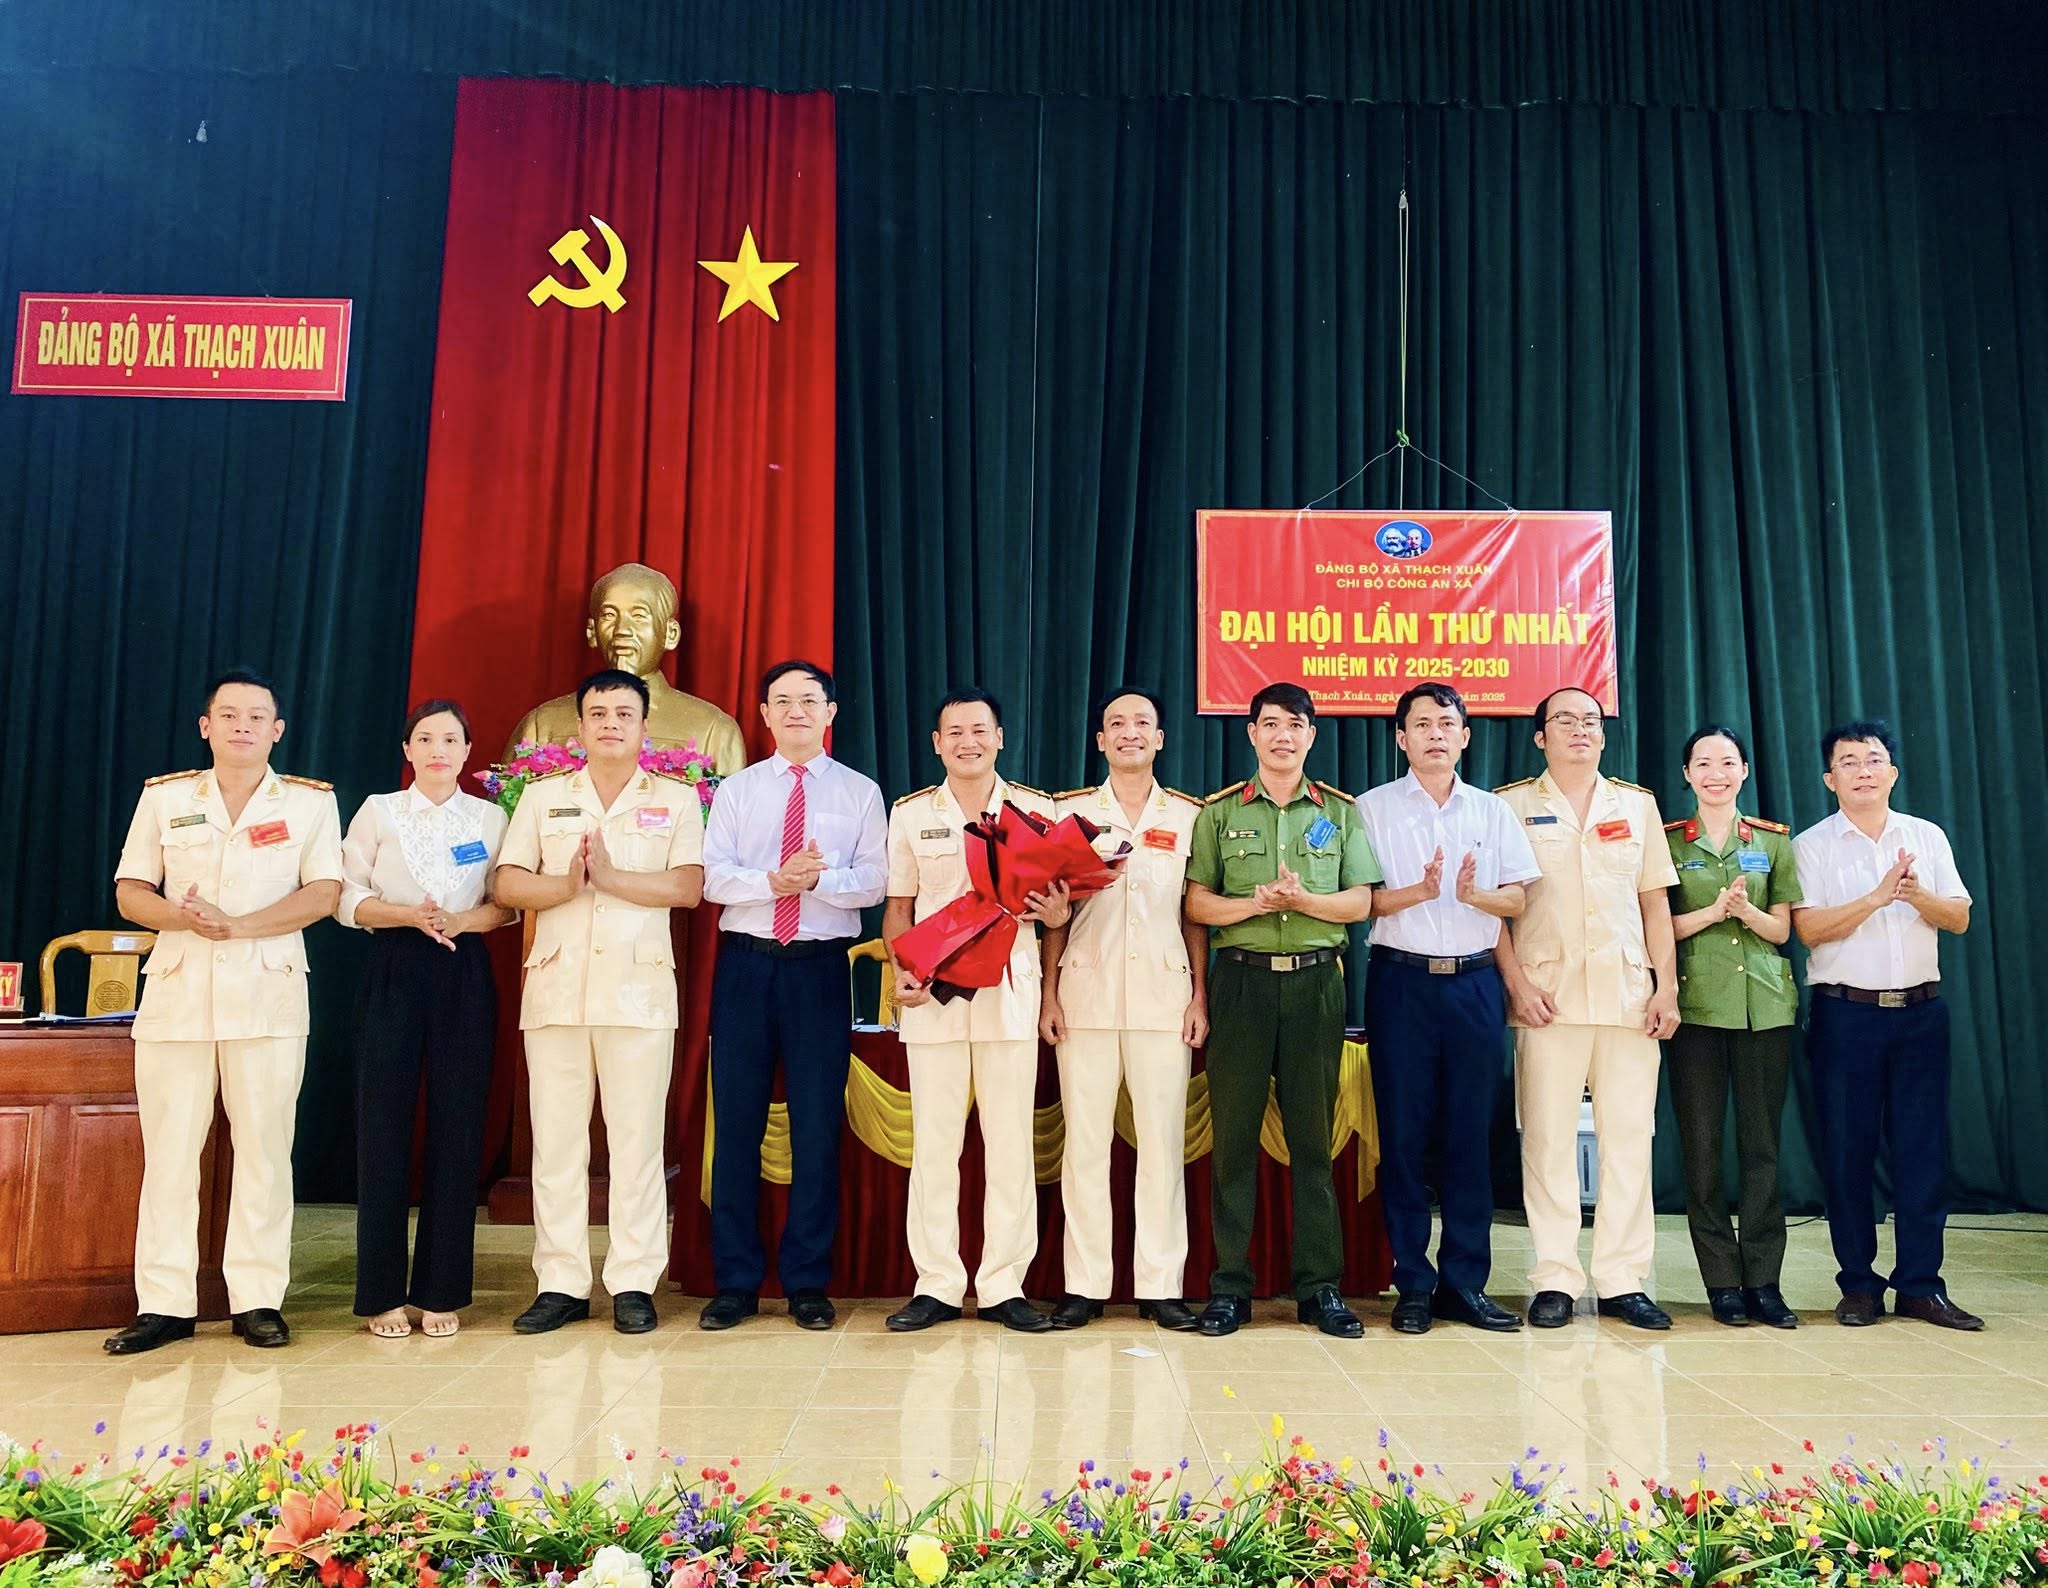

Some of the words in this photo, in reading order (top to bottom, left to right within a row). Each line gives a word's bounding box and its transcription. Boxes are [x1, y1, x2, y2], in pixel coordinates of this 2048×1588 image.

[37, 306, 102, 366] ĐẢNG
[107, 312, 140, 376] BỘ
[144, 314, 176, 367] XÃ
[184, 323, 257, 379] THẠCH
[261, 316, 326, 370] XUÂN
[1315, 561, 1355, 574] ĐẢNG
[1359, 562, 1379, 576] BỘ
[1382, 562, 1400, 574] XÃ
[1404, 564, 1451, 576] THẠCH
[1455, 563, 1492, 575] XUÂN
[1336, 578, 1360, 589] CHI
[1363, 577, 1384, 590] BỘ
[1387, 577, 1427, 589] CÔNG
[1431, 579, 1450, 589] AN
[1454, 577, 1473, 589] XÃ
[1219, 610, 1275, 649] ĐẠI
[1287, 605, 1342, 650] HỘI
[1353, 601, 1418, 644] LẦN
[1428, 606, 1496, 644] THỨ
[1503, 602, 1592, 644] NHẤT
[1302, 652, 1367, 681] NHIỆM
[1374, 653, 1399, 677] KỲ
[1405, 657, 1510, 678] 2025-2030
[1308, 690, 1340, 702] Thạch
[1342, 690, 1372, 702] Xuân,
[1481, 692, 1506, 702] 2025
